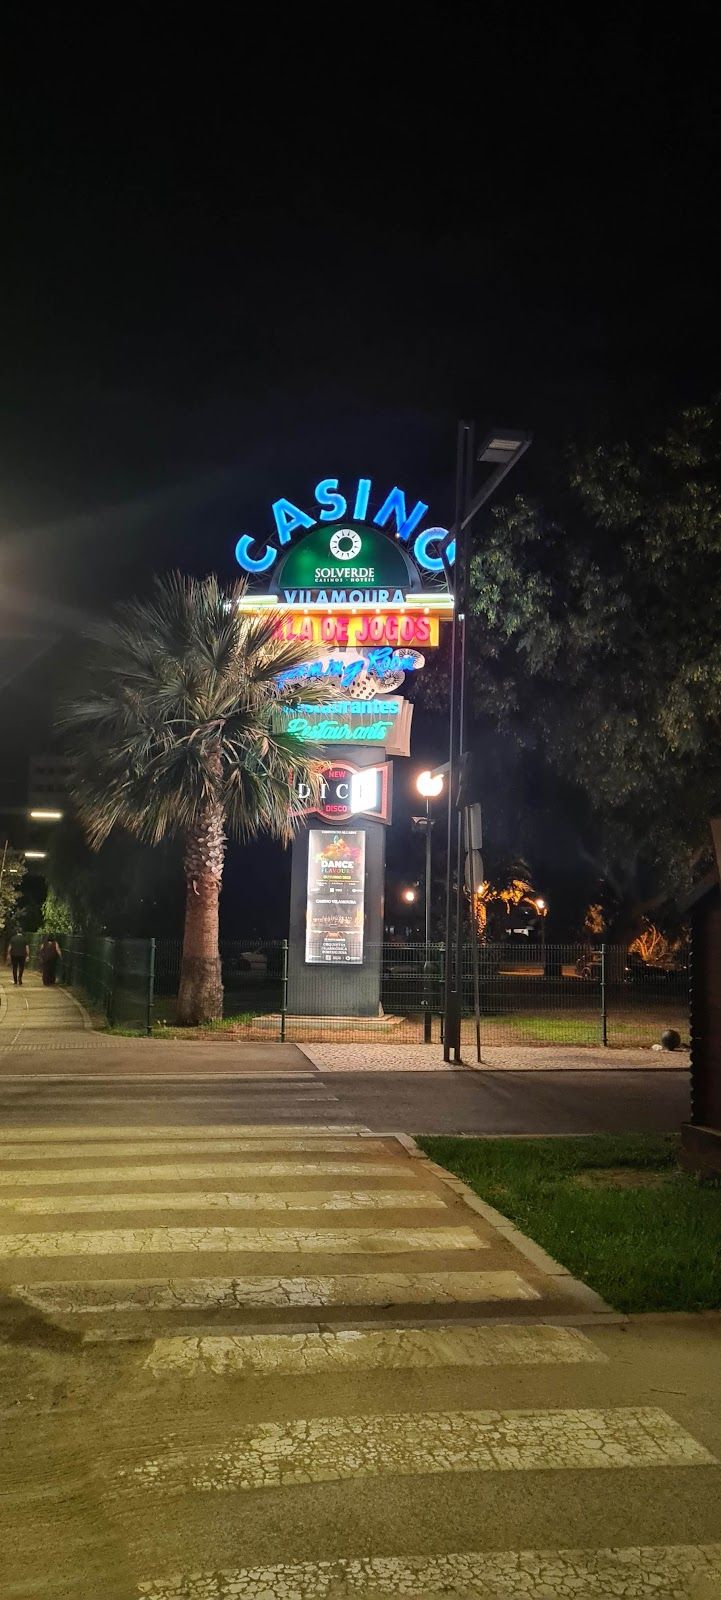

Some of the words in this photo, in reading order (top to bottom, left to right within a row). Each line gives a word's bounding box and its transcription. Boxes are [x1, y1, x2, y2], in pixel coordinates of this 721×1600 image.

[235, 478, 457, 573] CASINO
[314, 567, 375, 578] SOLVERDE
[284, 589, 406, 604] VILAMOURA
[320, 616, 350, 641] DE
[355, 615, 430, 642] JOGOS
[328, 770, 347, 778] NEW
[325, 803, 348, 812] DISCO
[321, 860, 355, 869] DANCE
